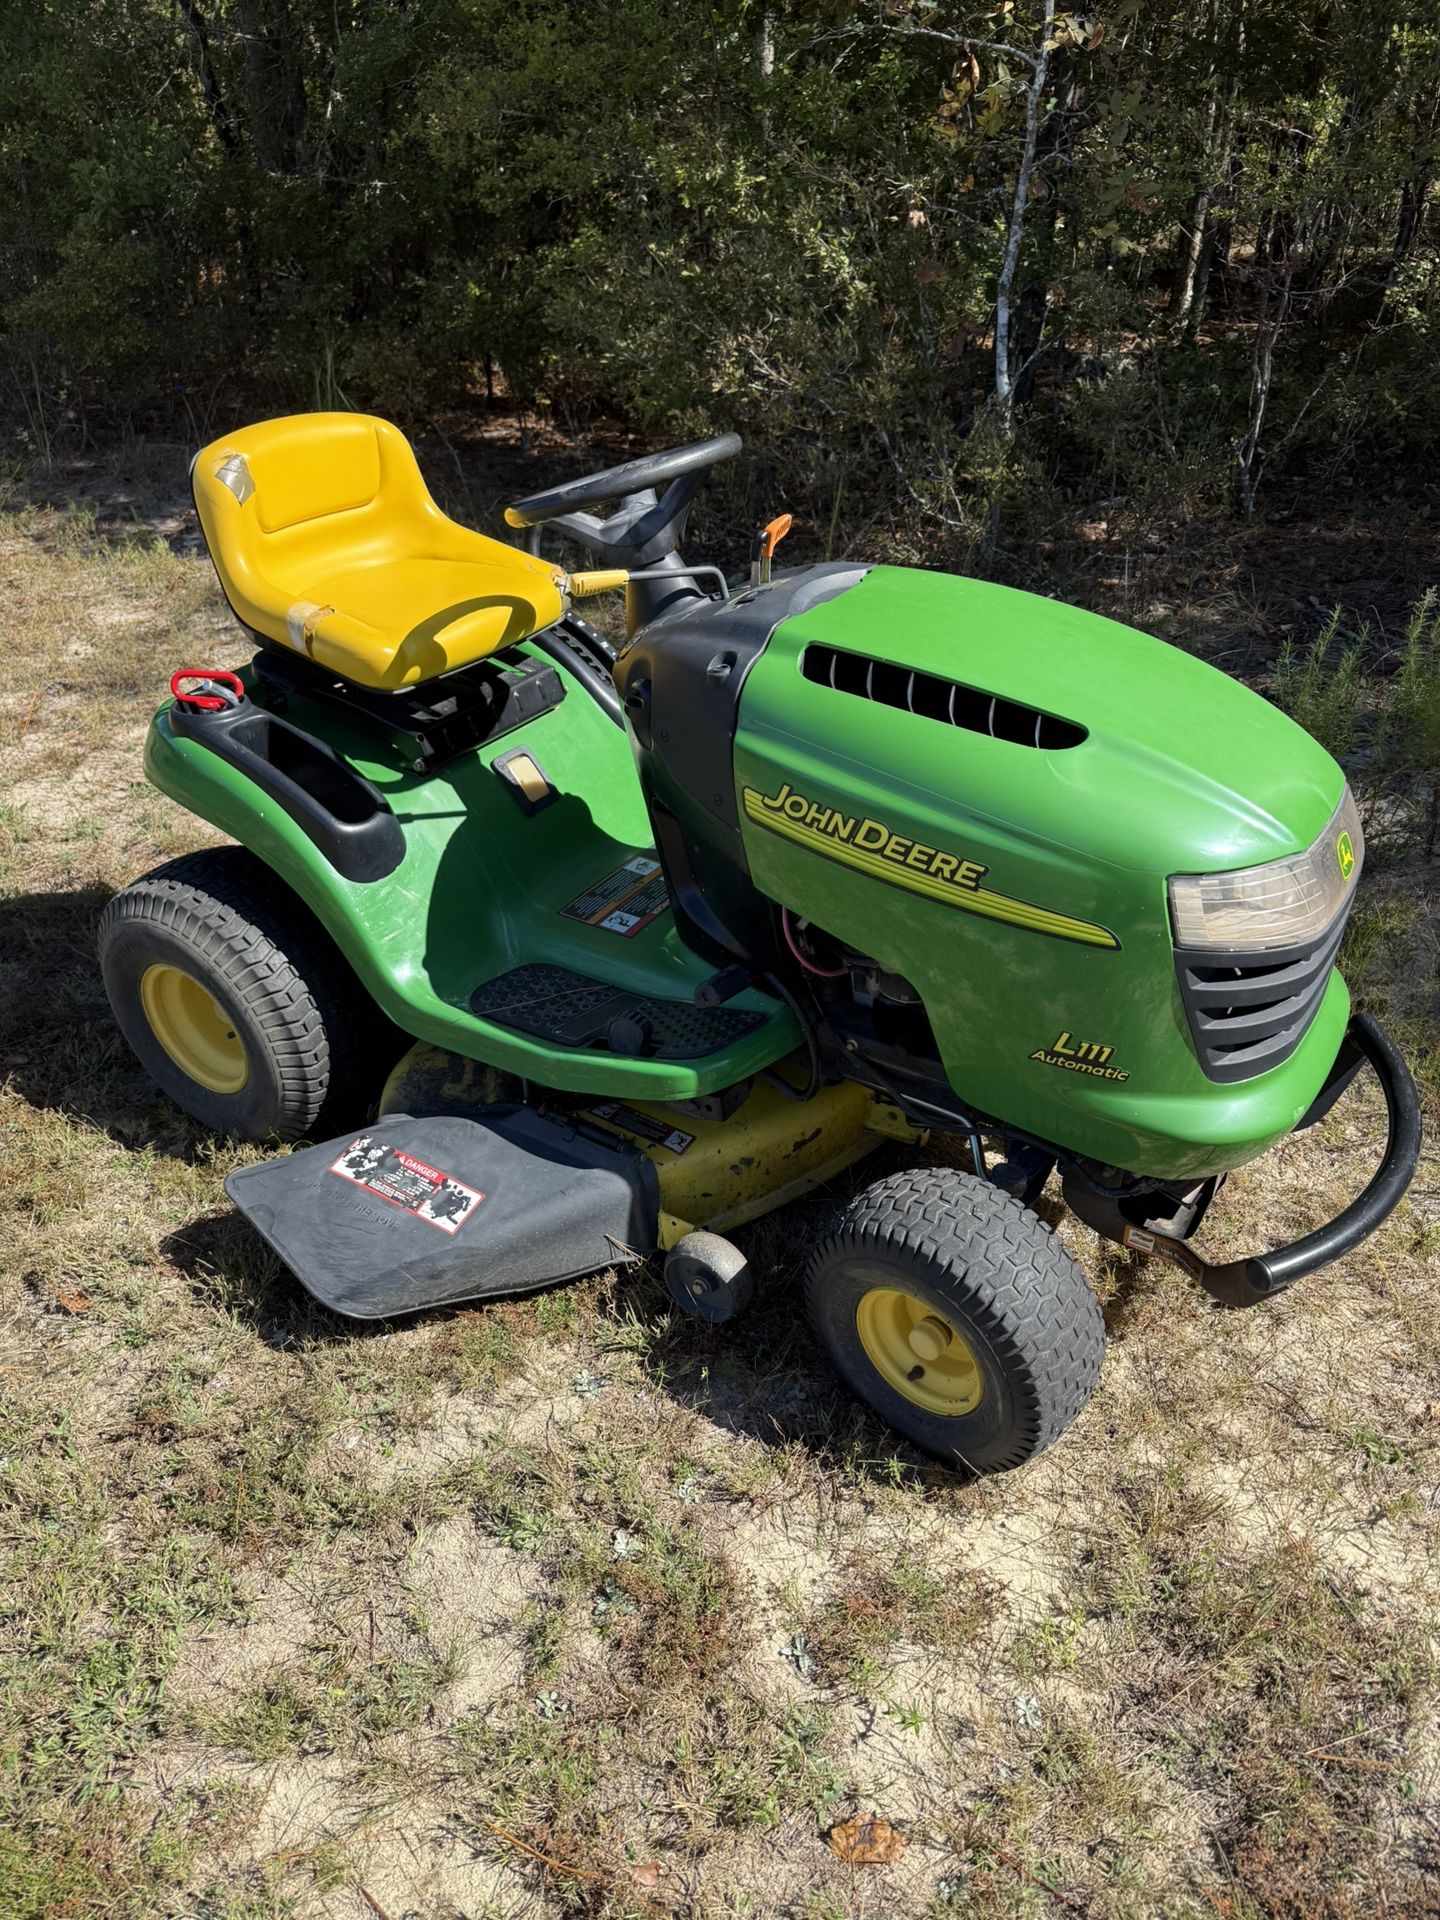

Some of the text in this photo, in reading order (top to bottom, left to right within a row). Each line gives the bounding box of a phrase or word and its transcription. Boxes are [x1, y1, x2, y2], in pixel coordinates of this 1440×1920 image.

[763, 784, 990, 891] JOHN DEERE
[1053, 1032, 1112, 1063] L111
[1031, 1050, 1129, 1081] Automatic
[404, 1158, 439, 1179] DANGER
